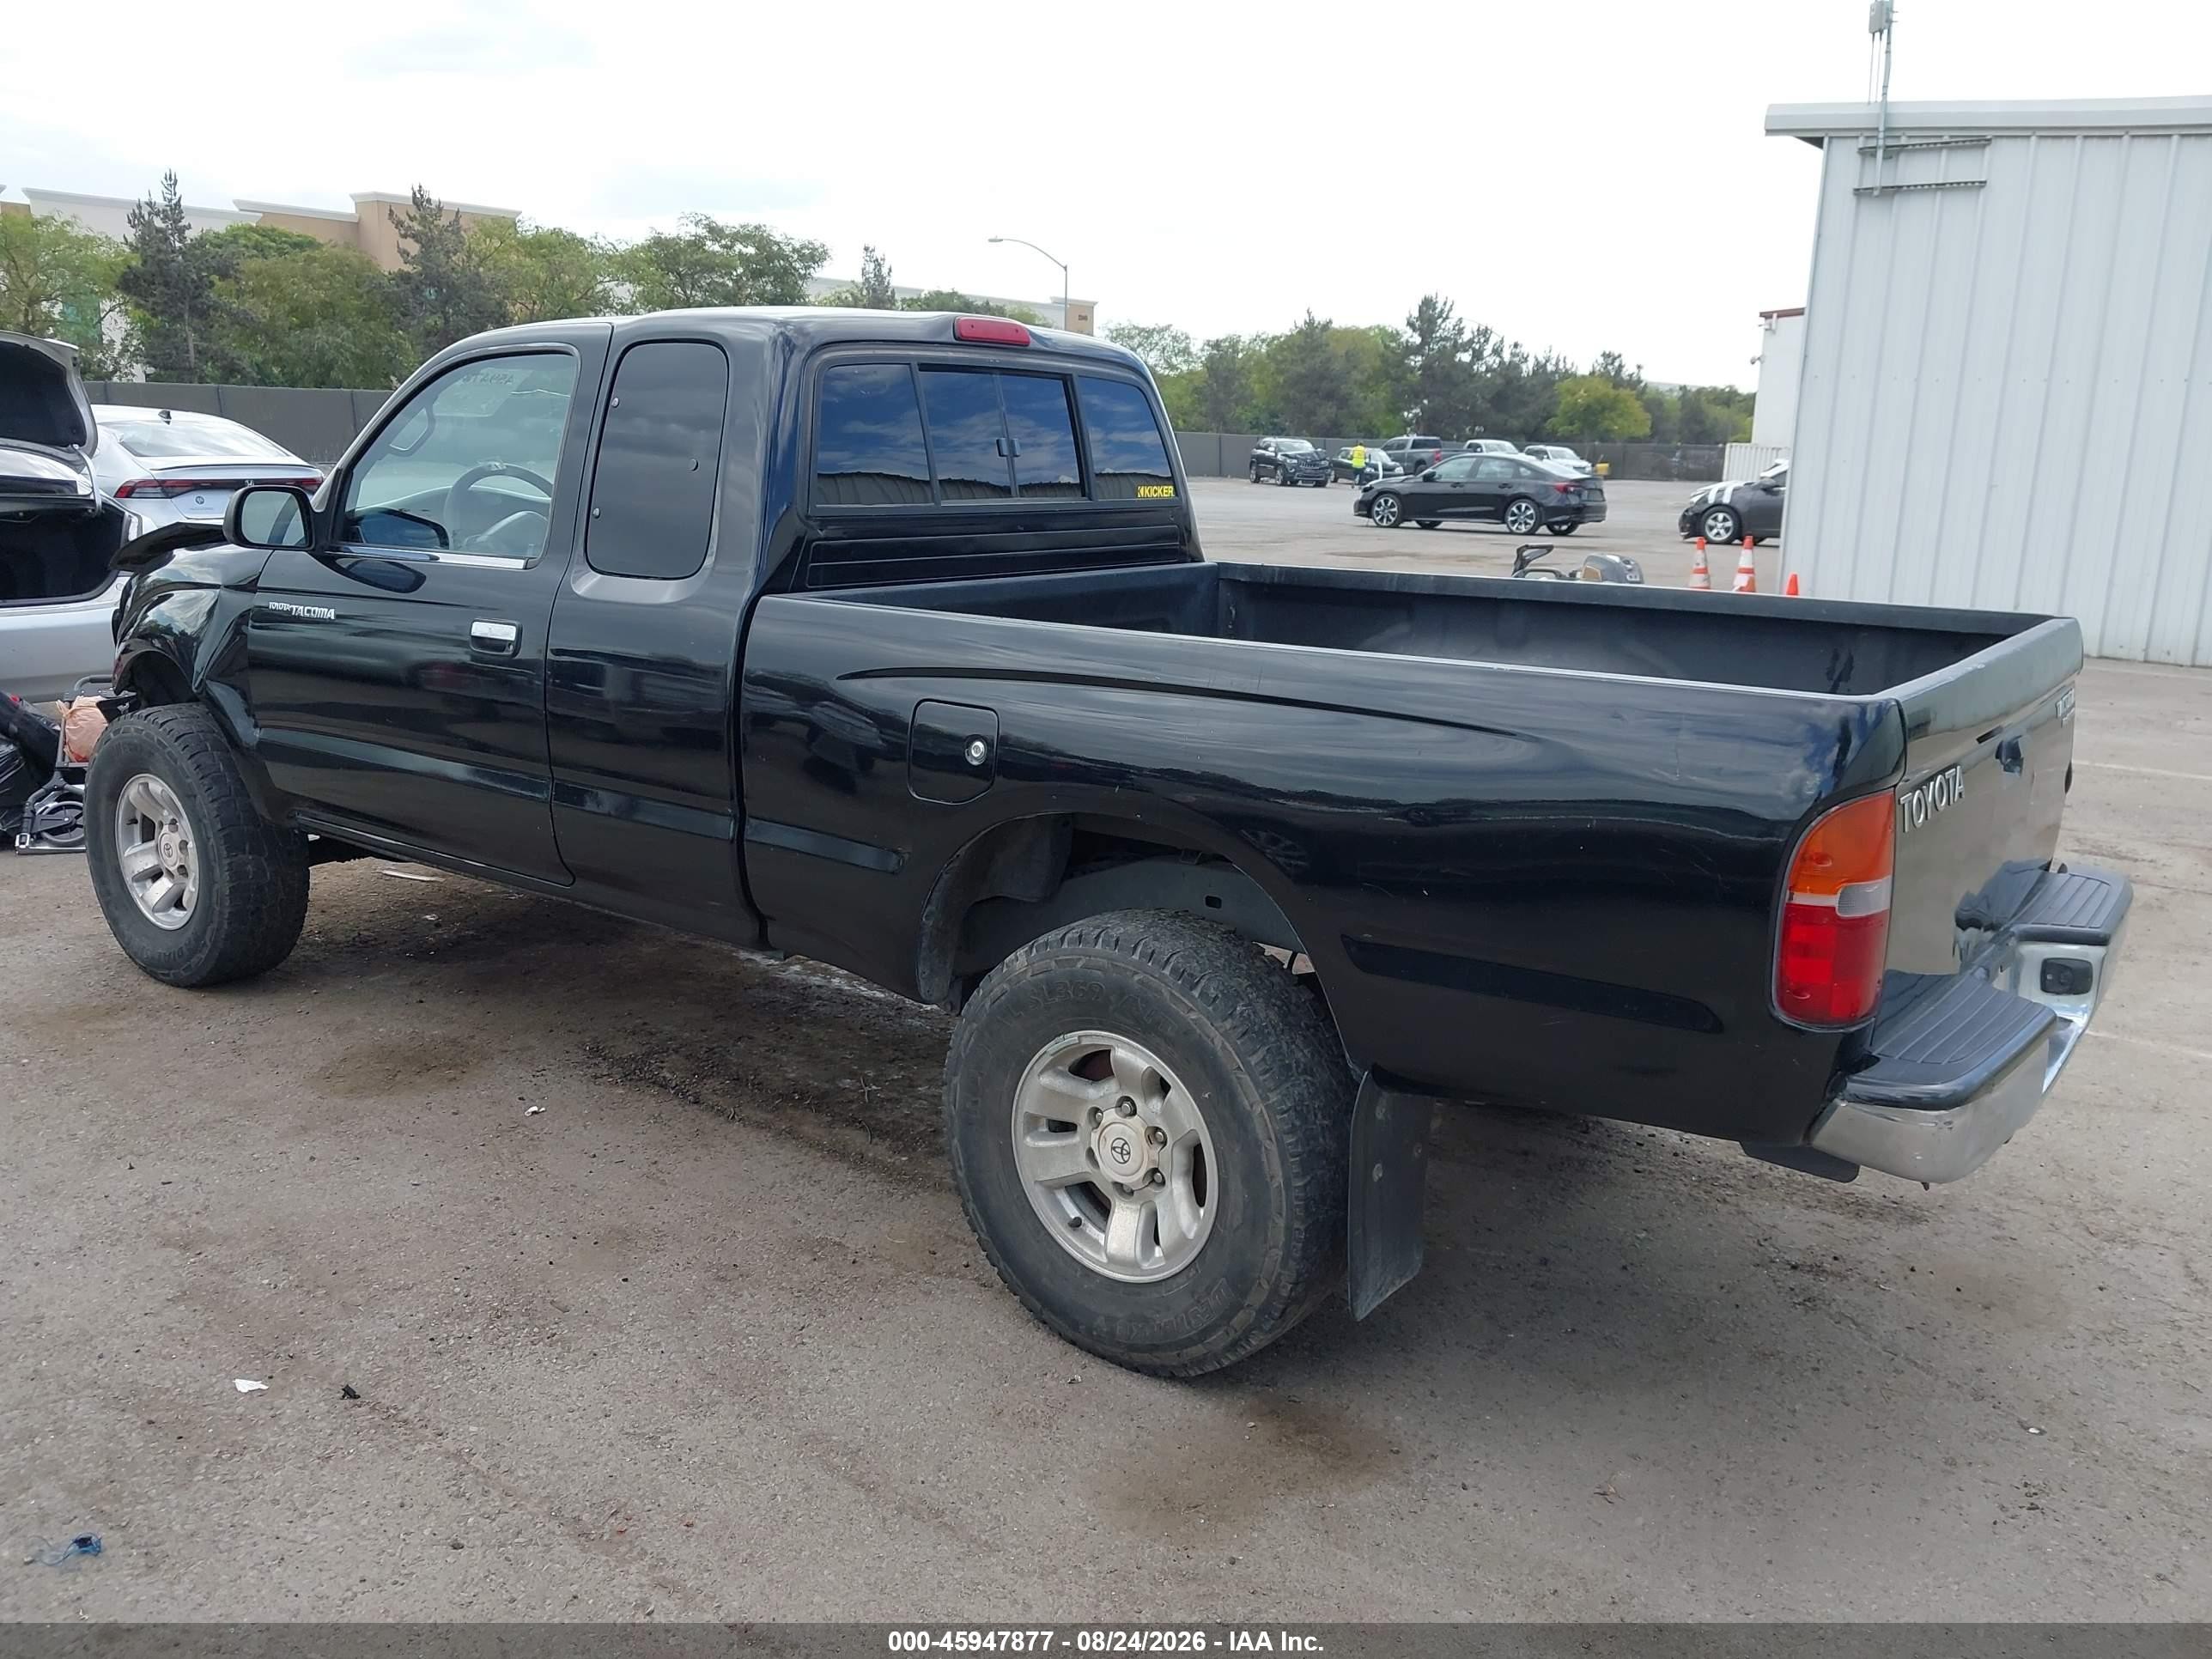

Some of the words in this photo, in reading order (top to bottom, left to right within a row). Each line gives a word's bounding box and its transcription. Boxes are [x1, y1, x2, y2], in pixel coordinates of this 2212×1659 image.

[1144, 485, 1176, 497] KICKER
[290, 605, 336, 620] TACOMA
[1899, 764, 1965, 834] TOYOTA
